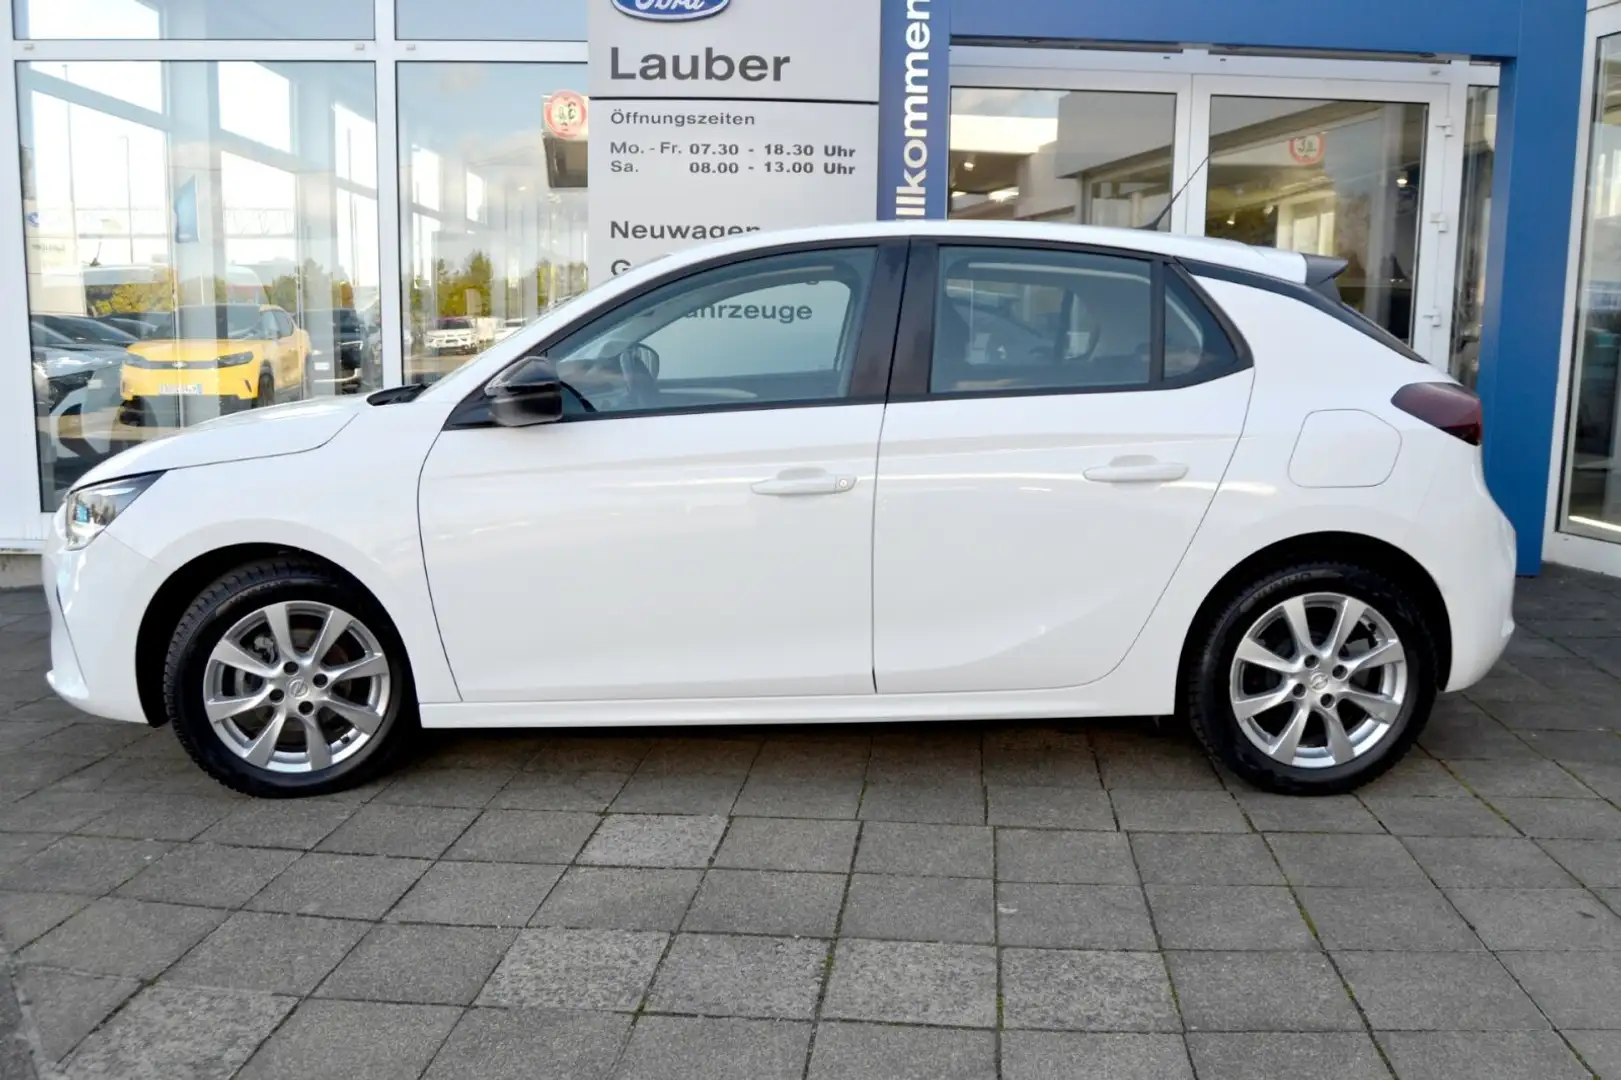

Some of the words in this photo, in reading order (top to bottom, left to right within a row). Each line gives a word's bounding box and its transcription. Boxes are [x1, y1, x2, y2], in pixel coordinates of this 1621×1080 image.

[611, 46, 791, 82] Lauber
[610, 108, 755, 127] Öffnungszeiten
[896, 0, 931, 221] llkommen
[610, 141, 645, 155] Mo.
[660, 141, 682, 154] Fr.
[689, 143, 739, 156] 07.30
[764, 143, 814, 157] 18.30
[823, 144, 856, 158] Uhr
[610, 160, 639, 173] Sa.
[689, 161, 739, 174] 08.00
[764, 161, 814, 174] 13.00
[823, 161, 856, 175] Uhr
